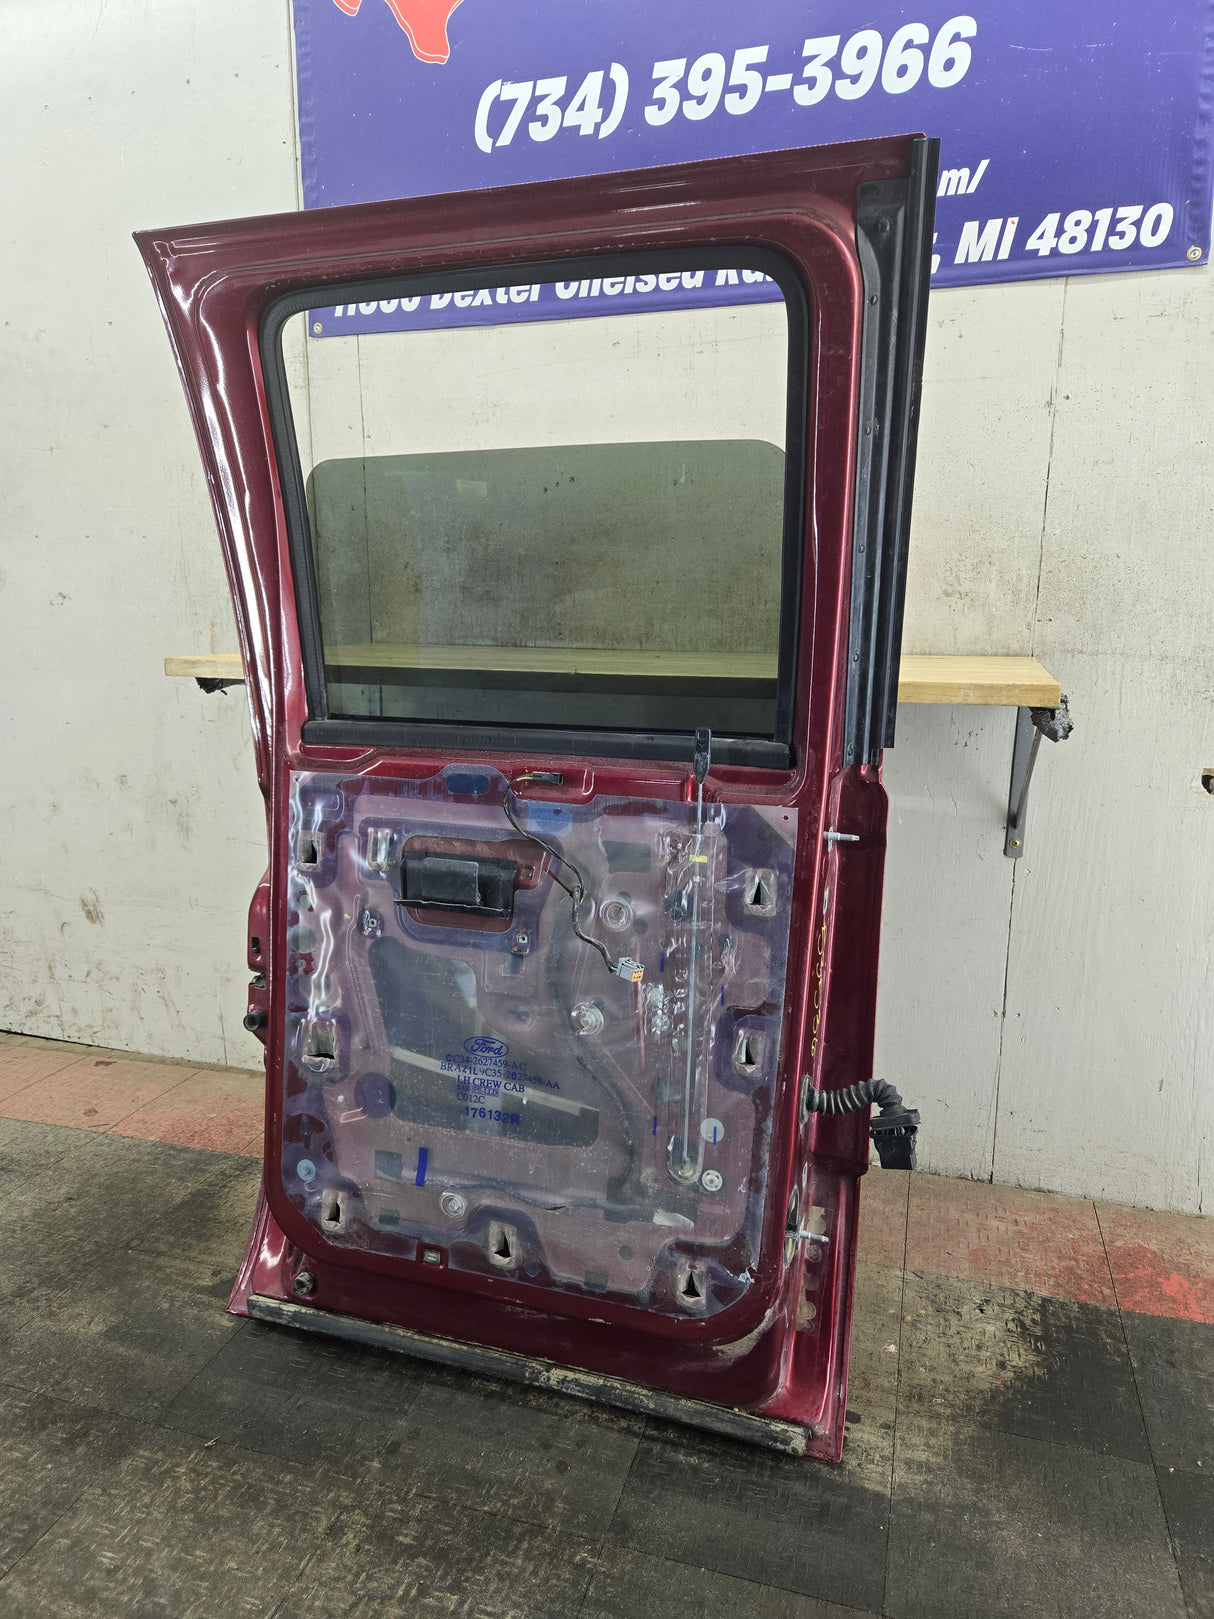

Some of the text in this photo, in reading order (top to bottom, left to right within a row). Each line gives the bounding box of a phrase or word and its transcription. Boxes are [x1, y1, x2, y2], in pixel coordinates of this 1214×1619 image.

[474, 15, 978, 154] (734) 395-3966
[953, 217, 1020, 265] MI
[1025, 202, 1175, 257] 48130
[470, 1038, 504, 1056] Ford
[457, 1074, 470, 1085] LH
[472, 1077, 502, 1089] CREW
[504, 1082, 525, 1093] CAB
[464, 1106, 520, 1125] 176132R
